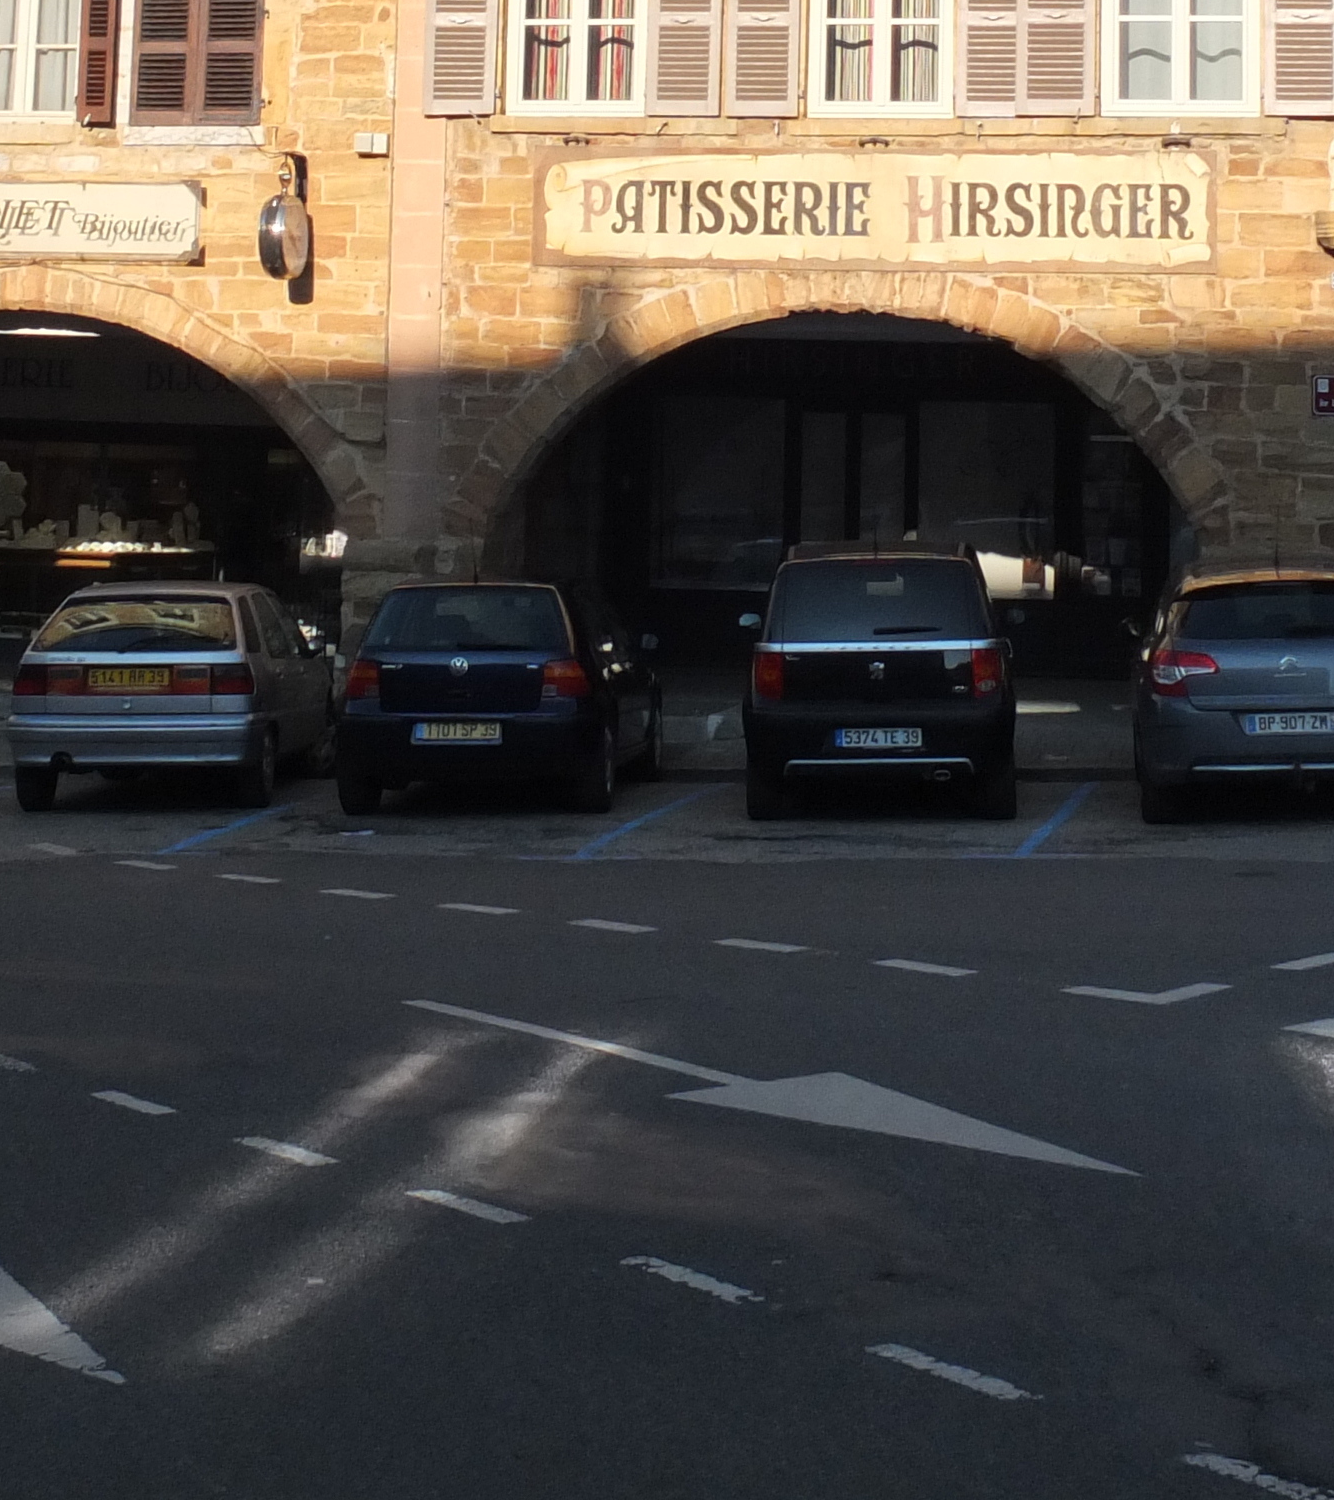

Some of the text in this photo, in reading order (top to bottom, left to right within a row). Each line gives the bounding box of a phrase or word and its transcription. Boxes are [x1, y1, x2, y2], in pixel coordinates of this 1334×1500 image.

[579, 175, 1195, 244] PATISSERIE HIRSINGER
[73, 213, 193, 246] Bijoutier
[844, 729, 919, 745] 5374 TE 39
